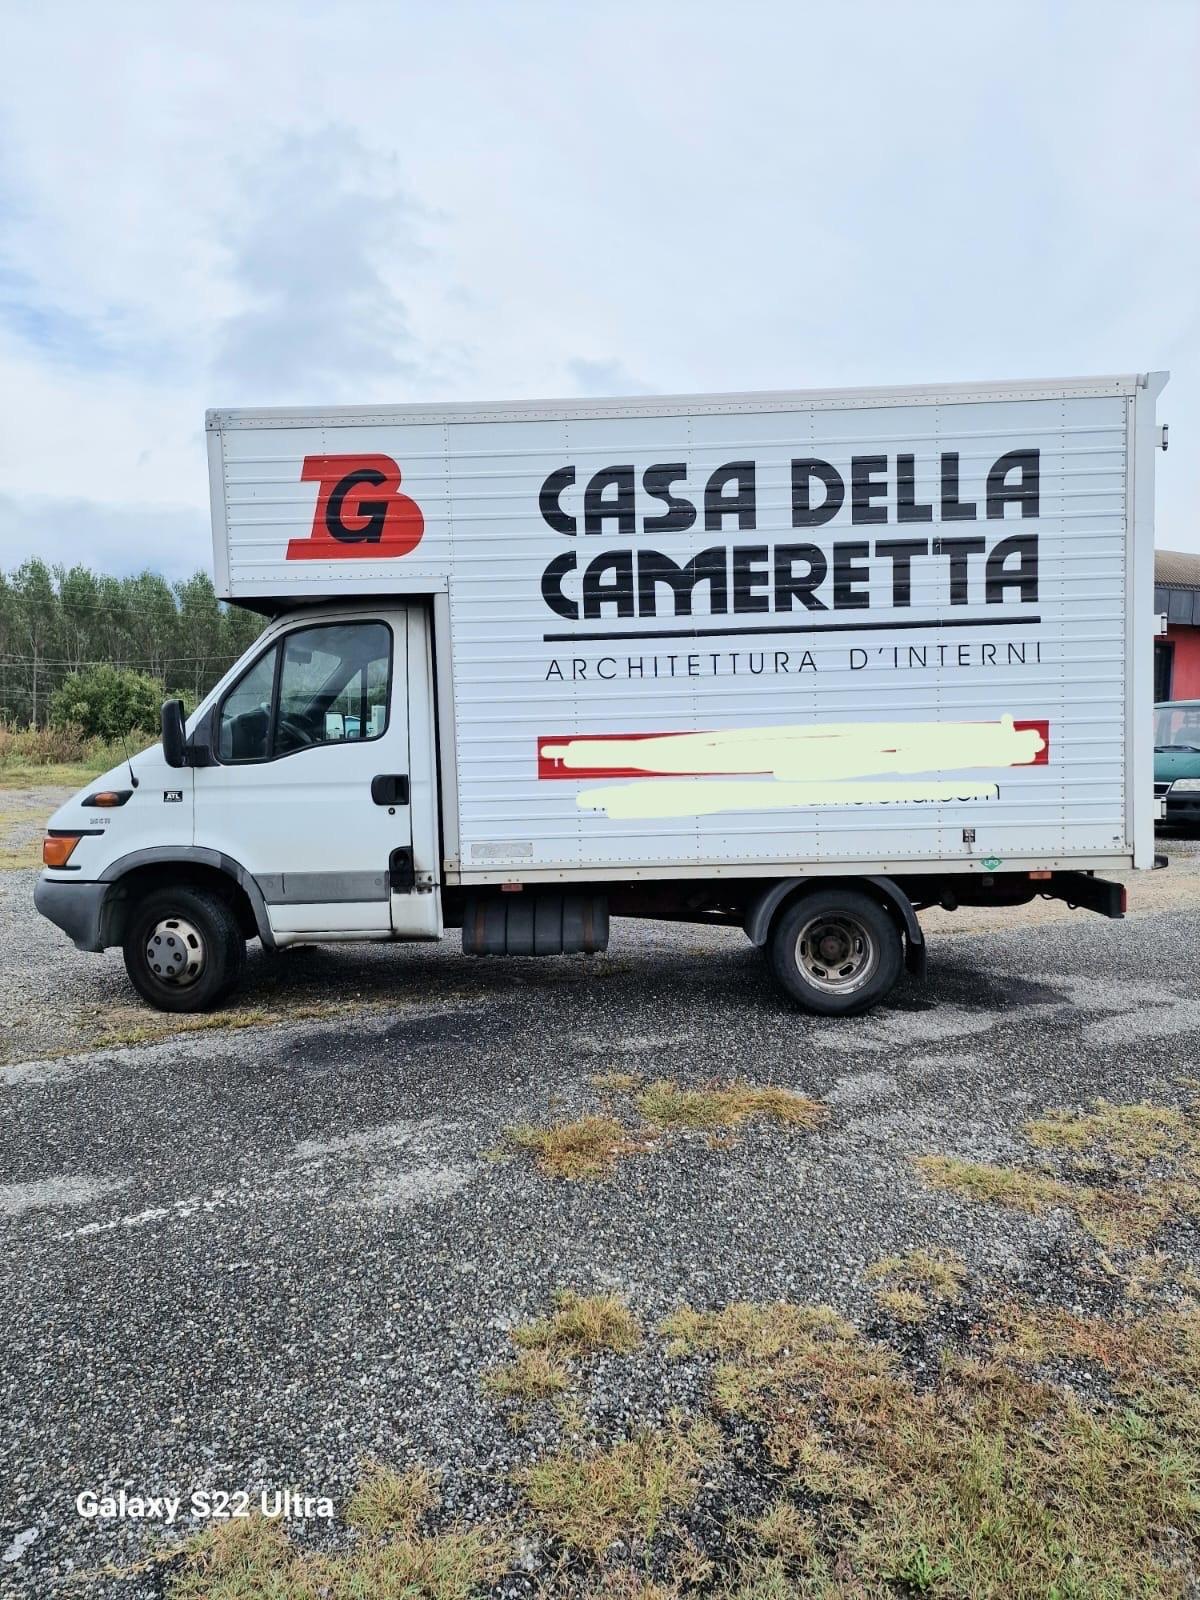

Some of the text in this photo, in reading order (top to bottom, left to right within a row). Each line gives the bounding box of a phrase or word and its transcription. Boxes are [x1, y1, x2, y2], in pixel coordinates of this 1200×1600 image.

[539, 448, 1040, 536] CASA DELLA
[541, 533, 1040, 620] CAMERETTA
[546, 649, 818, 680] ARCHITETTURA
